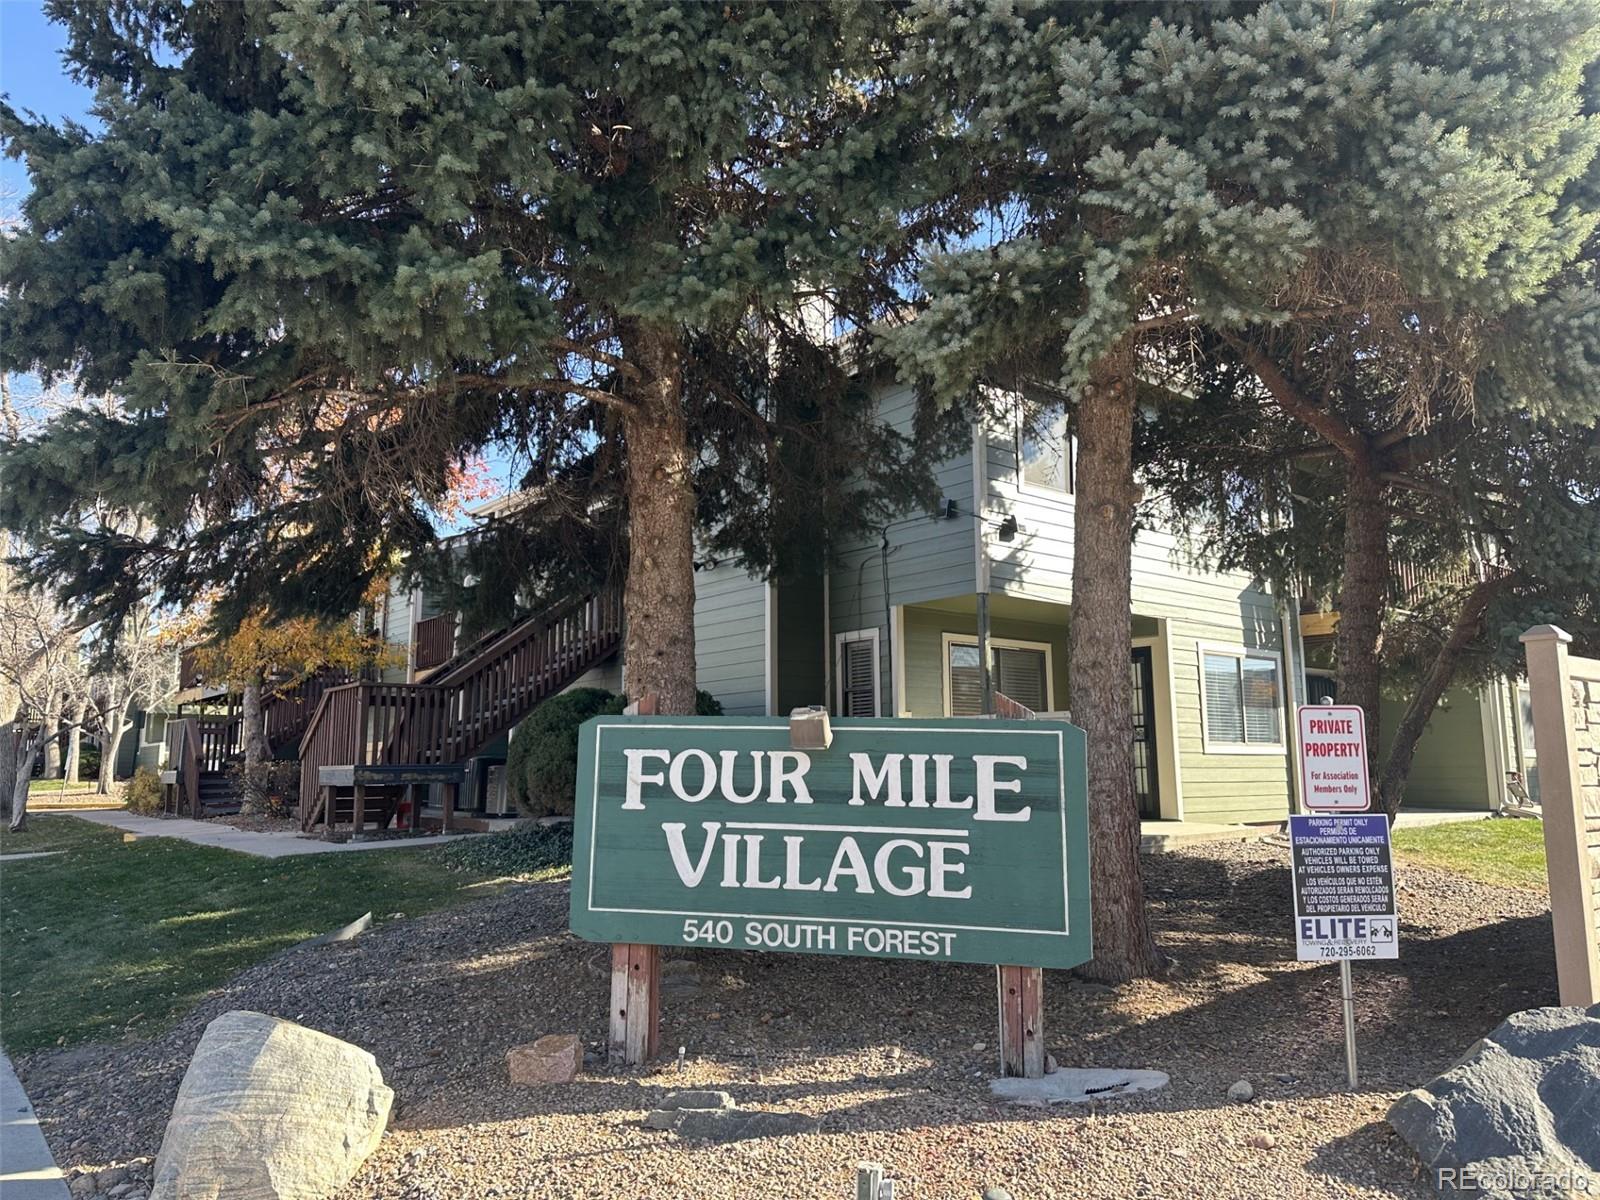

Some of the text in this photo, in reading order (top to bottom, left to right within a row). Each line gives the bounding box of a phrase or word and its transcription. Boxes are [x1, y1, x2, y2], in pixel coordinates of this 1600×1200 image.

[1310, 720, 1353, 734] PRIVATE
[1305, 743, 1360, 757] PROPERTY
[1311, 771, 1358, 780] For Association
[621, 749, 1031, 822] FOUR MILE
[1314, 785, 1357, 795] Members Only
[1349, 827, 1357, 835] DE
[1302, 848, 1337, 856] AUTHORIZED
[662, 822, 972, 899] VILLAGE
[1298, 866, 1305, 874] AT
[1336, 865, 1360, 873] OWNERS
[1362, 865, 1388, 873] EXPENSE
[1306, 878, 1316, 886] LOS
[1346, 878, 1357, 886] QUE
[1358, 877, 1365, 885] NO
[1340, 895, 1370, 903] GENERADOS
[1301, 918, 1366, 939] ELITE
[682, 920, 957, 956] 540 SOUTH FOREST
[1320, 946, 1376, 956] 720-295-6062
